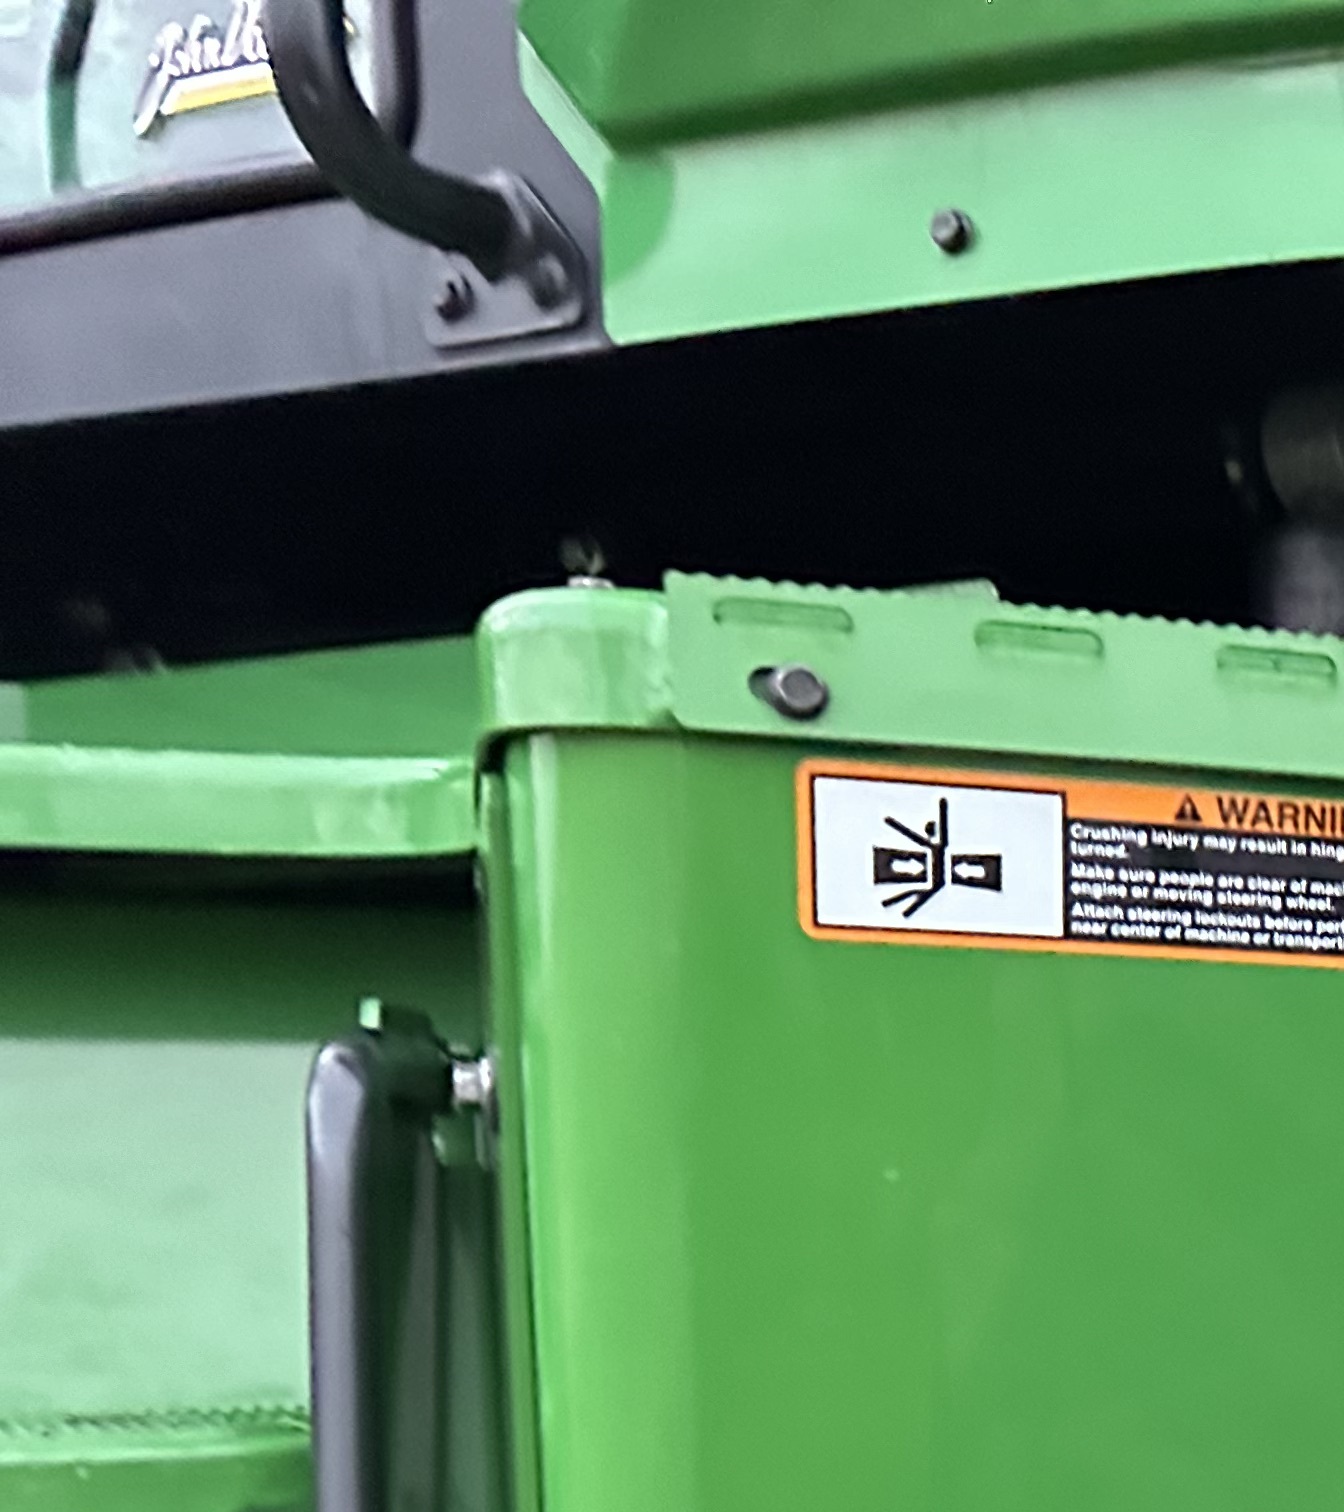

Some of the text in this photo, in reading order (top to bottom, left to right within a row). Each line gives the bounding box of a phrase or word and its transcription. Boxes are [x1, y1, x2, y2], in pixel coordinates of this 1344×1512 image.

[1070, 823, 1148, 847] Crushing
[1151, 829, 1199, 851] injury
[1203, 835, 1236, 853] may
[1240, 837, 1287, 855] result
[1291, 840, 1306, 856] in
[1159, 868, 1213, 889] people
[1217, 875, 1244, 889] are
[1247, 876, 1287, 892] clear
[1290, 879, 1307, 894] of
[1071, 882, 1127, 899] engine
[1131, 886, 1148, 898] or
[1153, 887, 1213, 907] moving
[1217, 890, 1282, 910] steering
[1072, 902, 1124, 920] Attach
[1127, 907, 1192, 926] steering
[1264, 914, 1313, 932] before
[1110, 923, 1160, 938] center
[1164, 925, 1181, 939] of
[1184, 927, 1250, 944] machine
